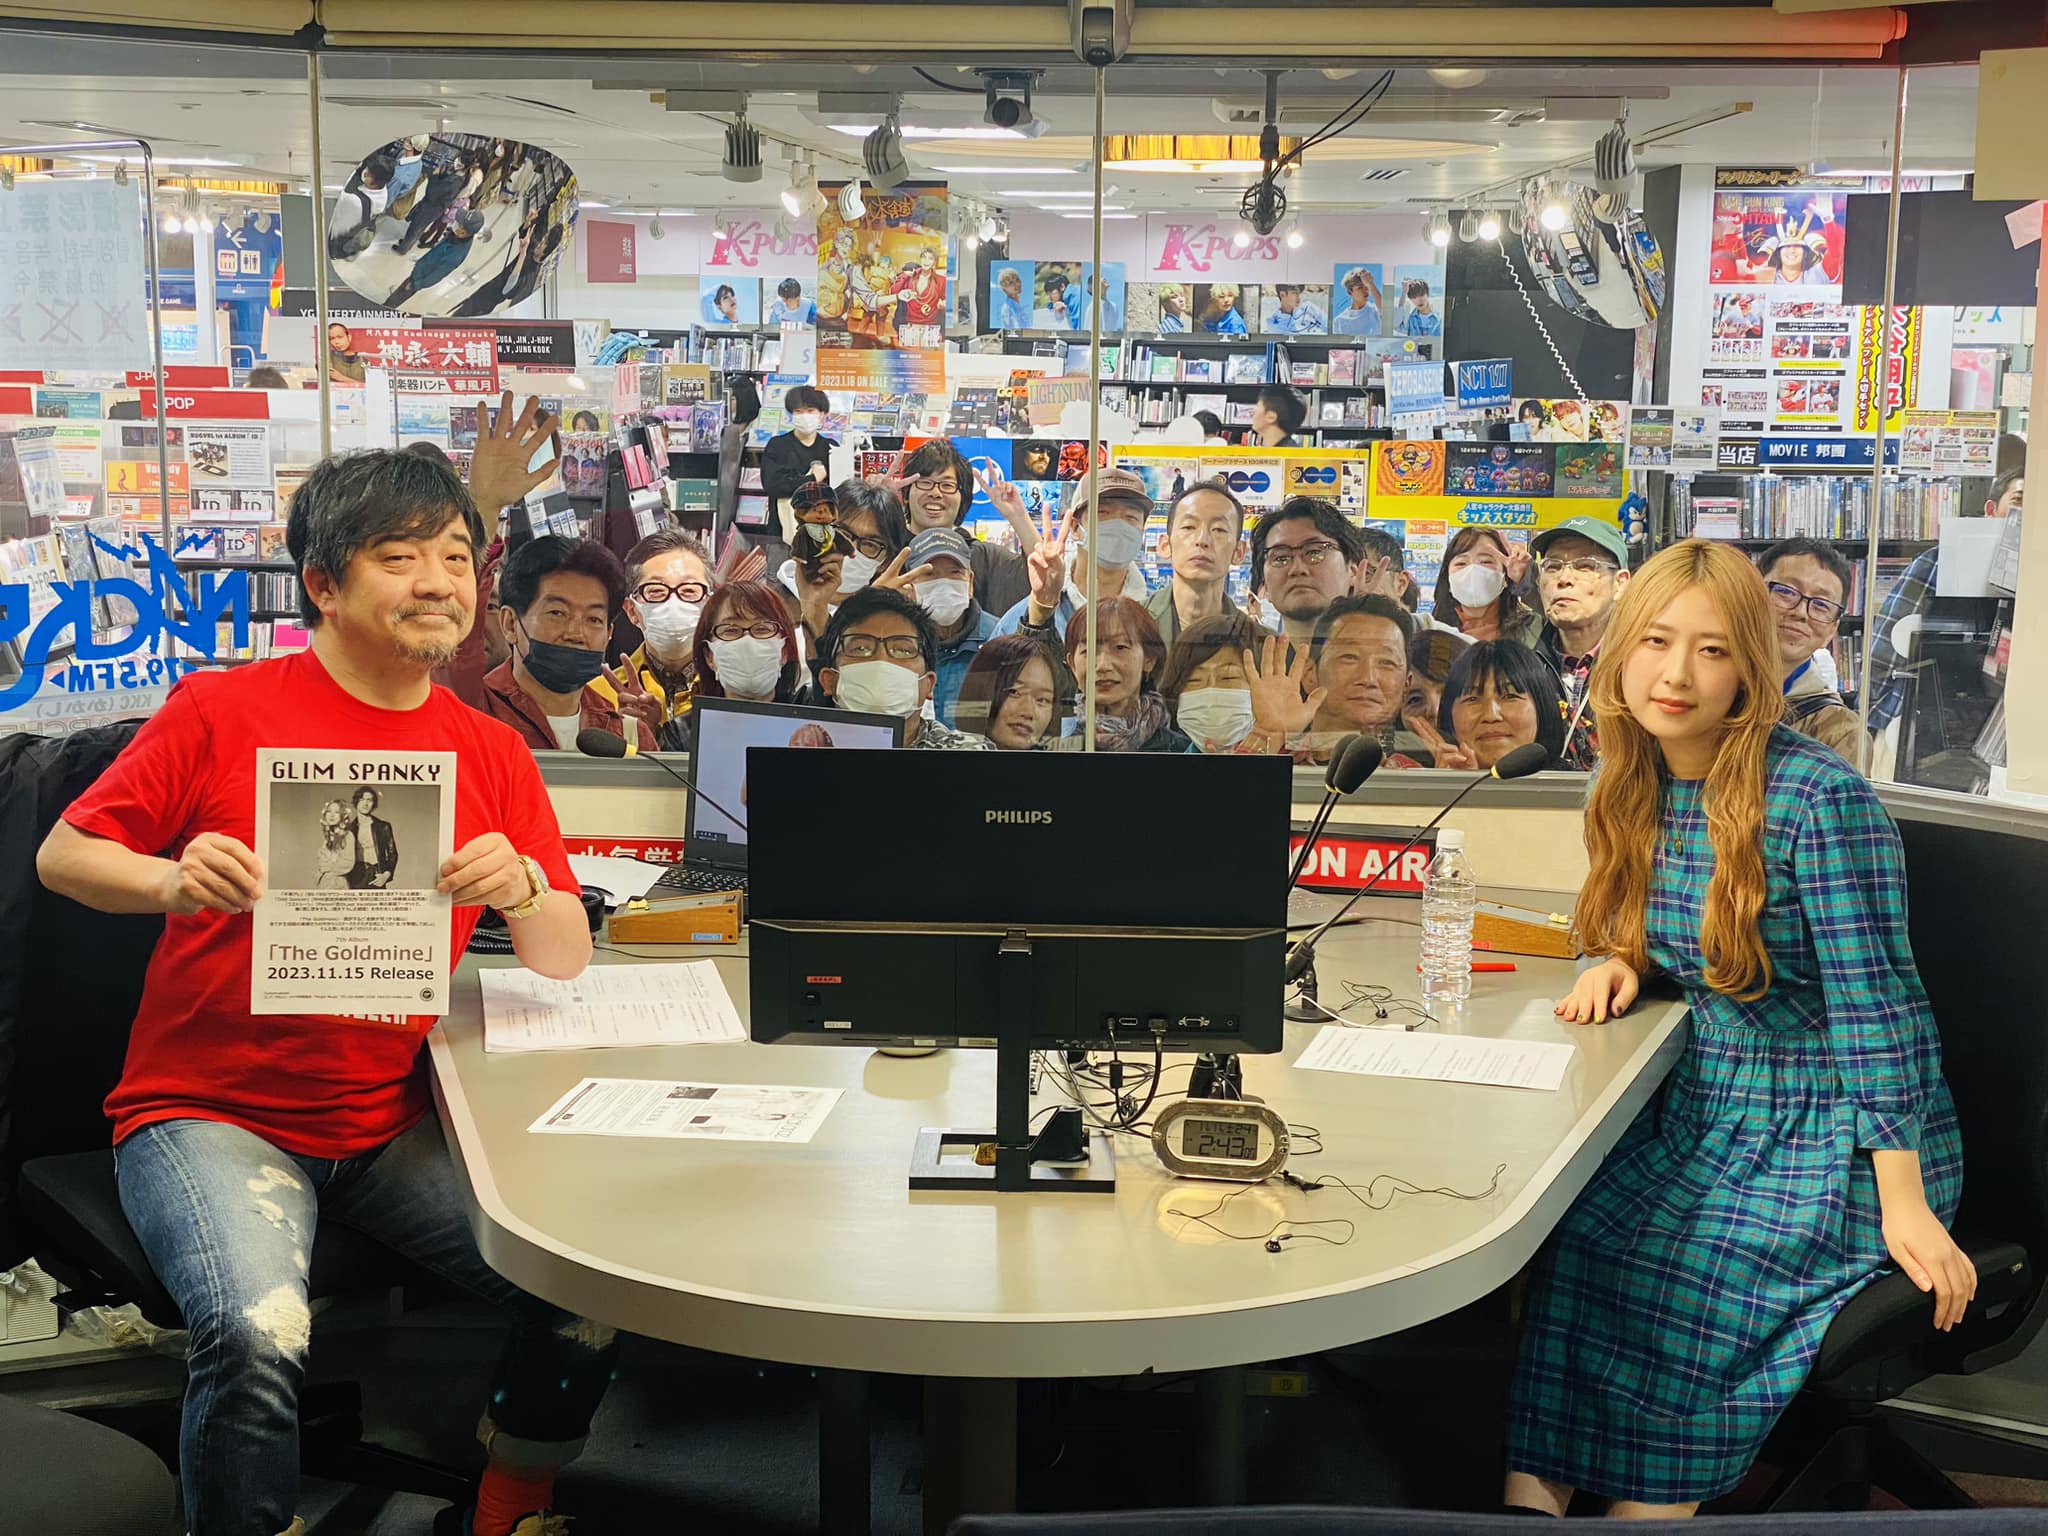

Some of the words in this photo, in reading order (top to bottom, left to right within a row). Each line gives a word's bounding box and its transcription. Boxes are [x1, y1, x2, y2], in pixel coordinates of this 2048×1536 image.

[706, 221, 818, 267] K-POPS
[1153, 223, 1281, 272] K-POPS
[300, 309, 316, 319] YG
[328, 309, 404, 319] TERTAINMENT
[134, 371, 169, 380] J-PP
[1460, 364, 1487, 391] NCT
[1488, 363, 1508, 389] 127
[152, 397, 195, 410] JPOP
[1719, 446, 1756, 464] 当店
[1768, 443, 1808, 457] MOVIE
[1864, 444, 1897, 457] おい
[272, 761, 335, 780] GLIM
[349, 763, 441, 782] SPANKY
[985, 810, 1053, 824] PHILIPS
[1292, 846, 1346, 878] ON
[1358, 849, 1429, 883] AIR
[269, 944, 318, 962] 「The
[325, 944, 433, 962] Goldmine」
[267, 966, 365, 980] 2023.11.15
[370, 966, 435, 980] Release
[1198, 1134, 1246, 1158] 2:43
